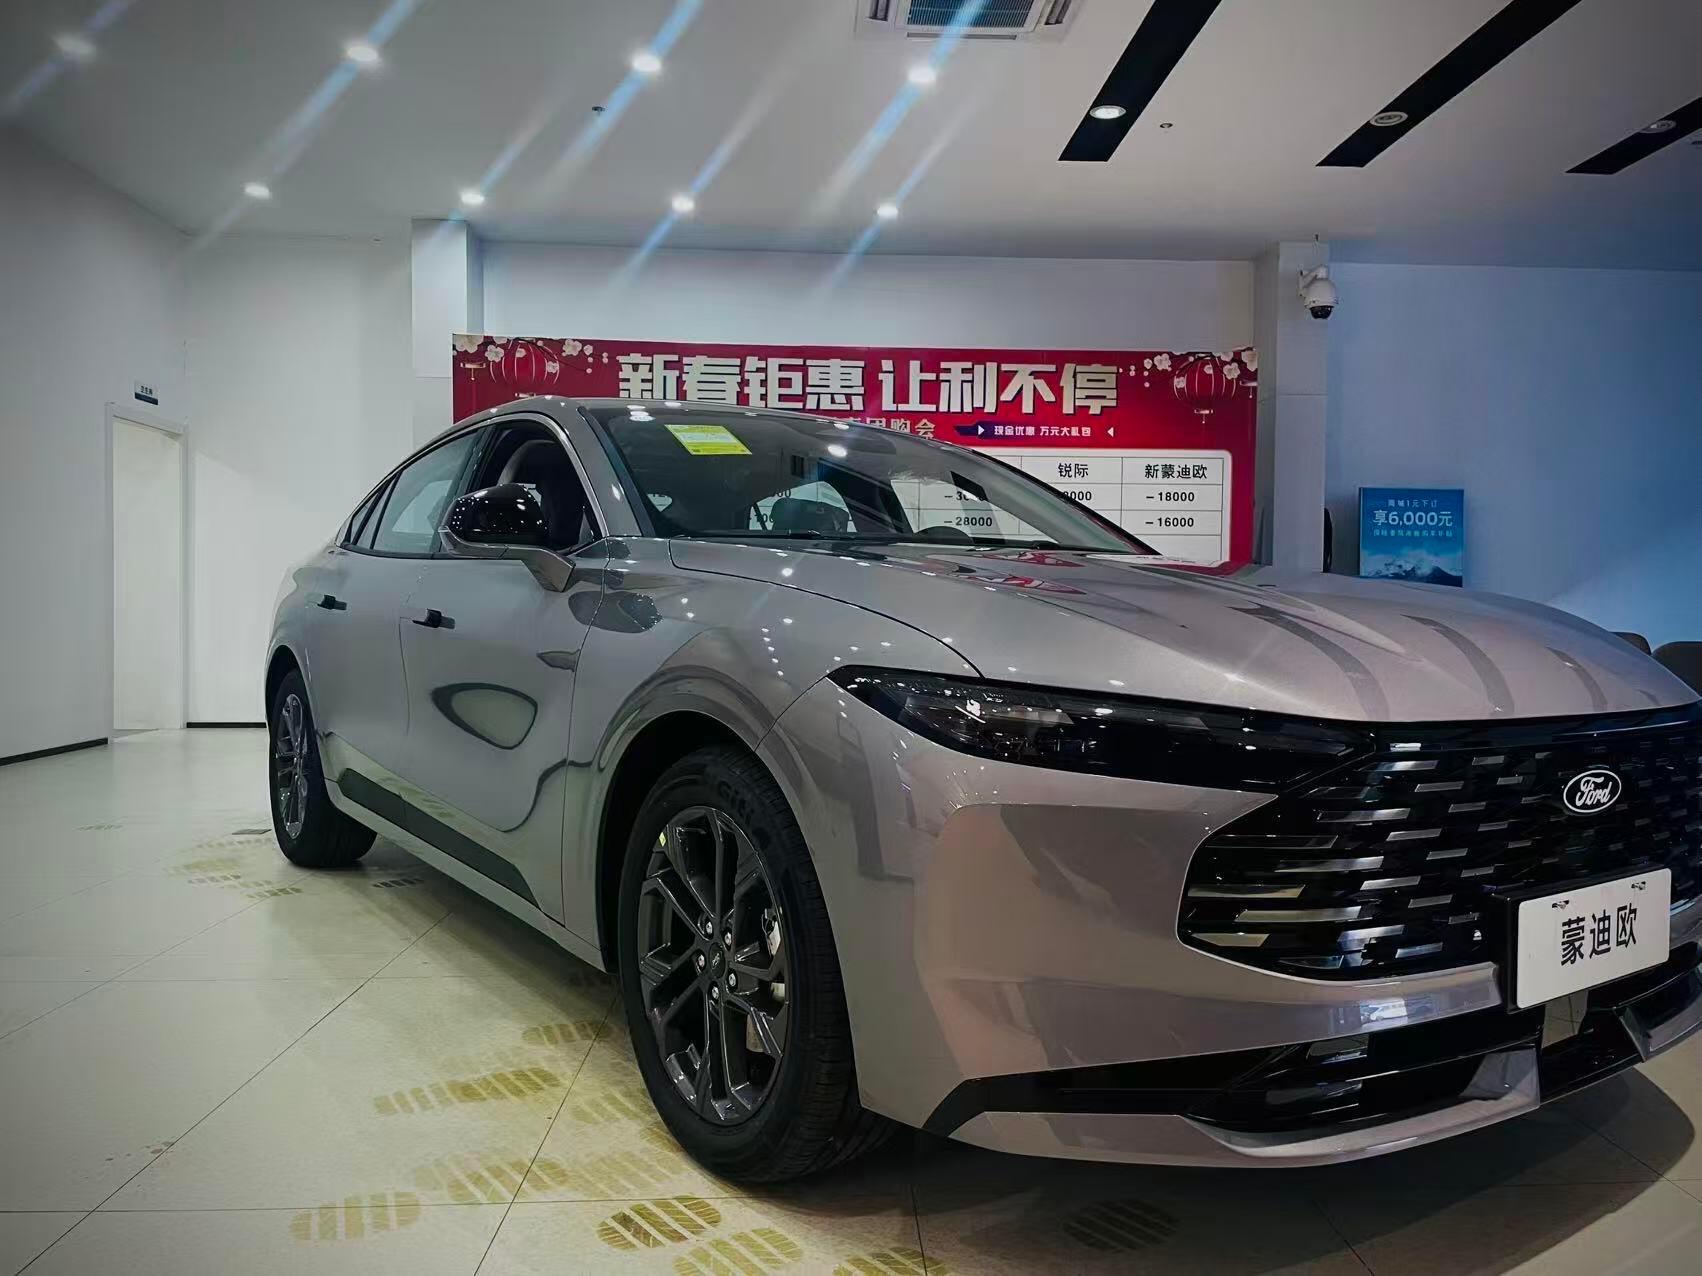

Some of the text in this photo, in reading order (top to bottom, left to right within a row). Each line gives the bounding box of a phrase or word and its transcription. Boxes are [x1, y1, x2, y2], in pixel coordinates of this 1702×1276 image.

[616, 353, 1118, 415] 新春钜惠 让利不停
[994, 425, 1091, 437] 现金优惠 万元大礼包
[1058, 463, 1208, 480] 锐际 新蒙迪欧
[1372, 509, 1453, 527] 享6,000元
[1575, 776, 1613, 807] Ford
[1561, 902, 1637, 967] 蒙迪欧
